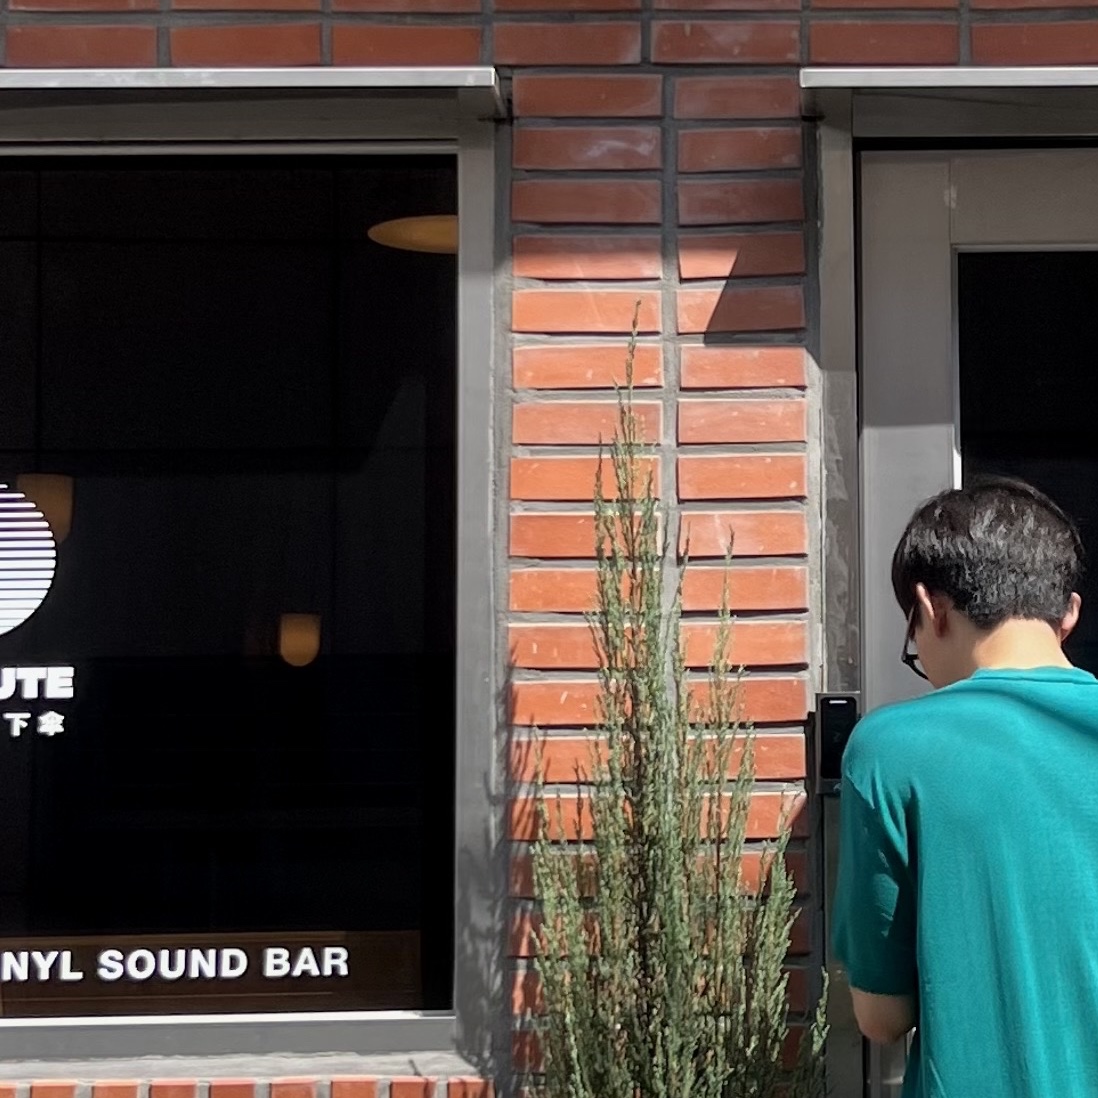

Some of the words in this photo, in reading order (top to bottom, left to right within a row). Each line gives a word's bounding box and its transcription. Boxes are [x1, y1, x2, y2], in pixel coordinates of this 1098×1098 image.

[1, 951, 84, 981] NYL
[97, 948, 248, 980] SOUND
[264, 947, 349, 977] BAR
